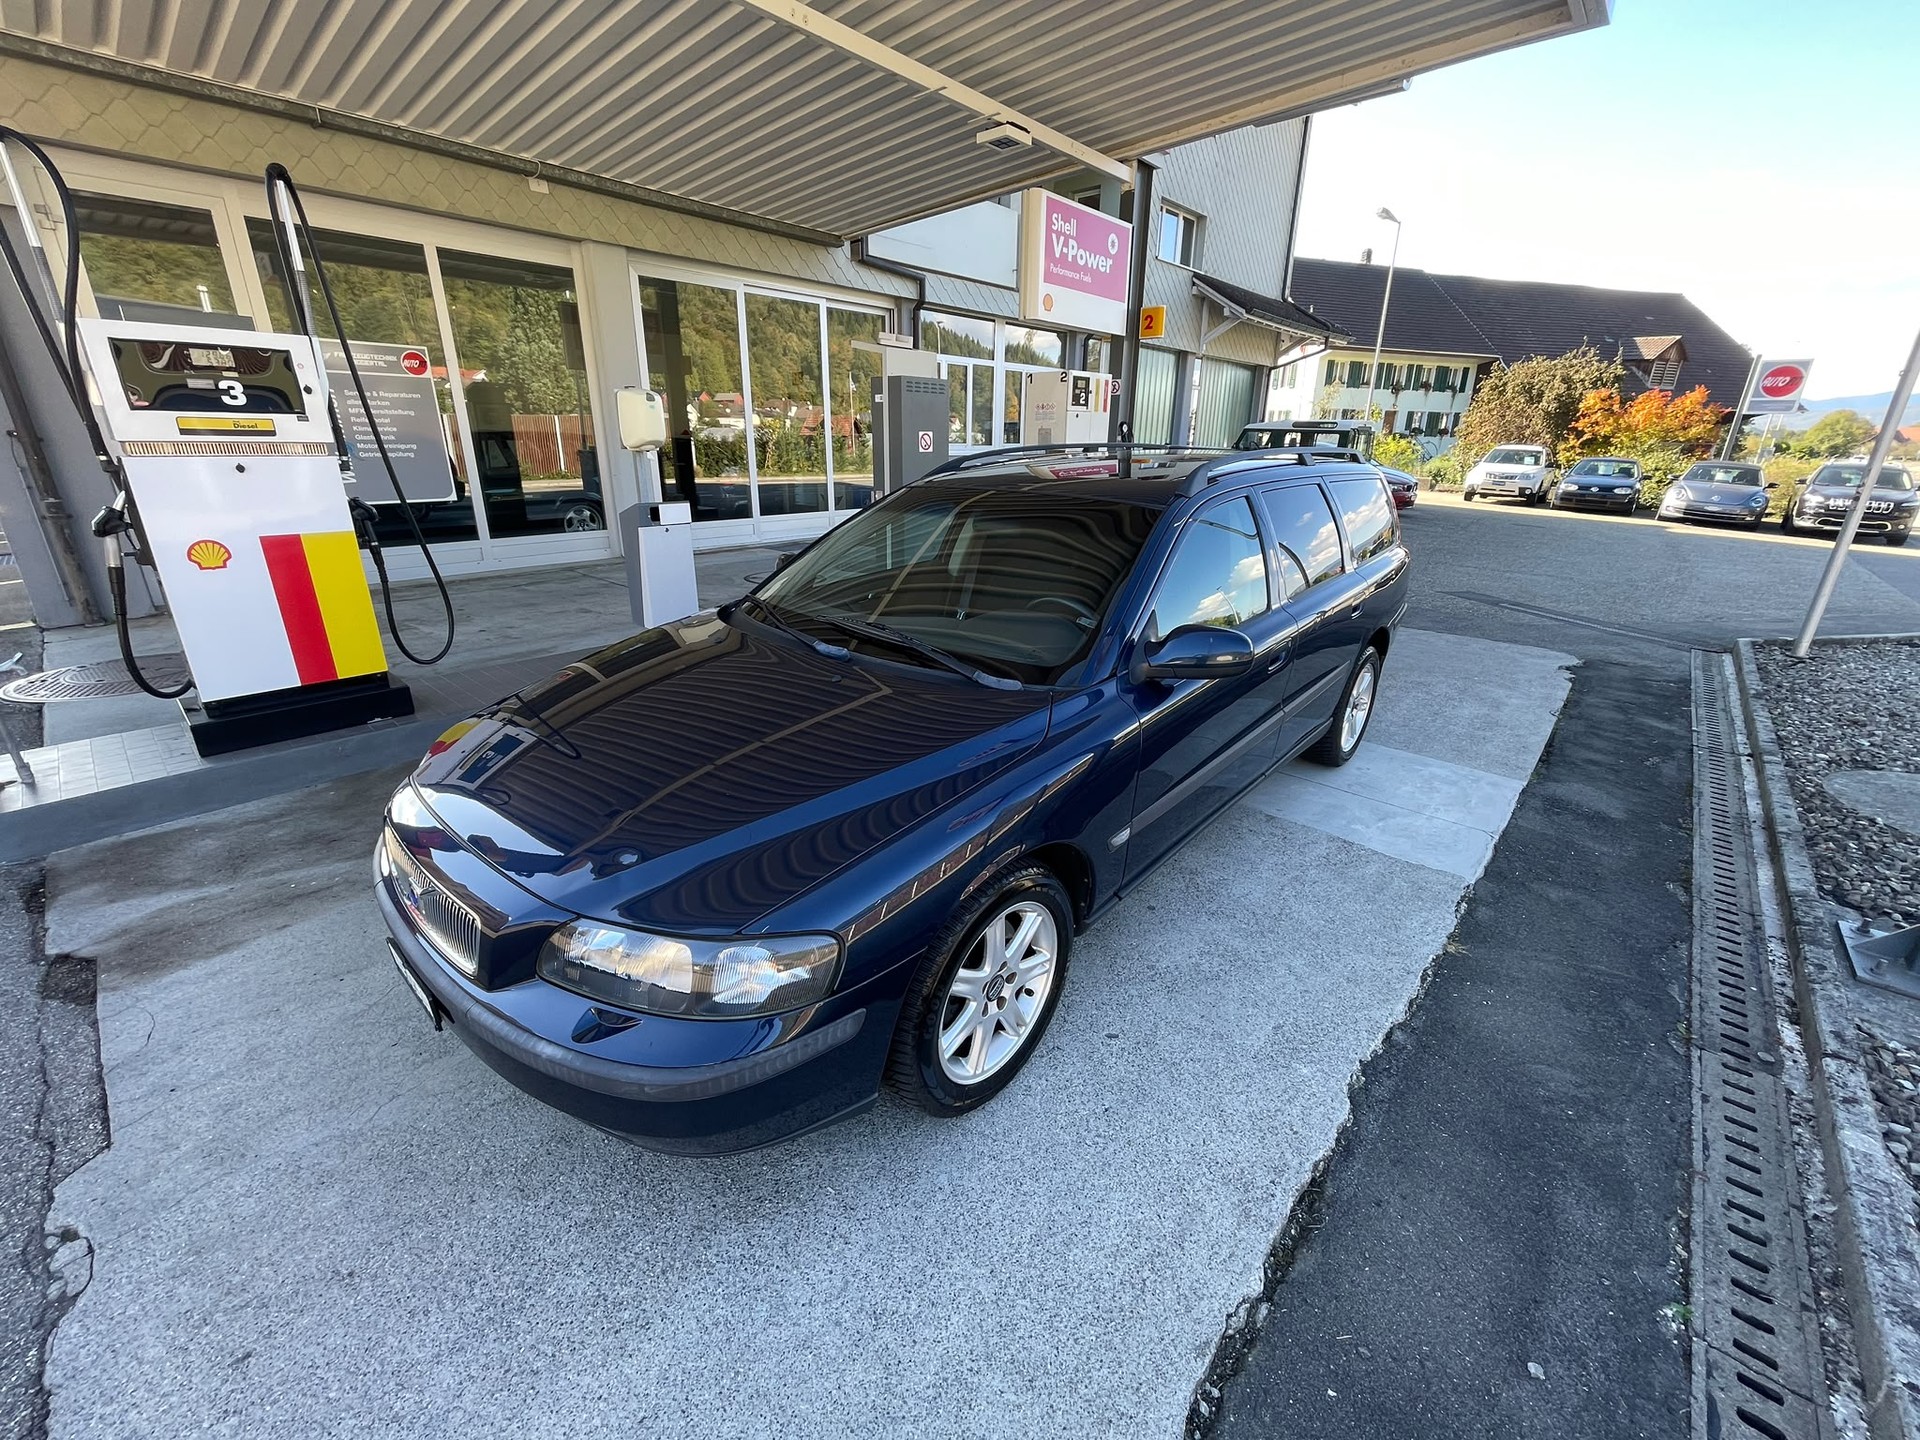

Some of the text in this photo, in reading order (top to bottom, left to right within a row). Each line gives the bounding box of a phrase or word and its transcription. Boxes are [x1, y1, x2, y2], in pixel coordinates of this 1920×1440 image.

[1051, 212, 1077, 237] Shell
[1051, 232, 1113, 274] V-Power
[1049, 262, 1092, 283] Performance Fuels
[1143, 314, 1154, 330] 2
[403, 358, 420, 368] AUTO
[1027, 371, 1068, 384] 1 2
[1762, 376, 1791, 387] AUTO
[218, 380, 247, 405] 3
[343, 389, 371, 397] Serve
[372, 389, 378, 397] &
[1079, 392, 1086, 404] 2
[359, 451, 415, 459] Getriespülung
